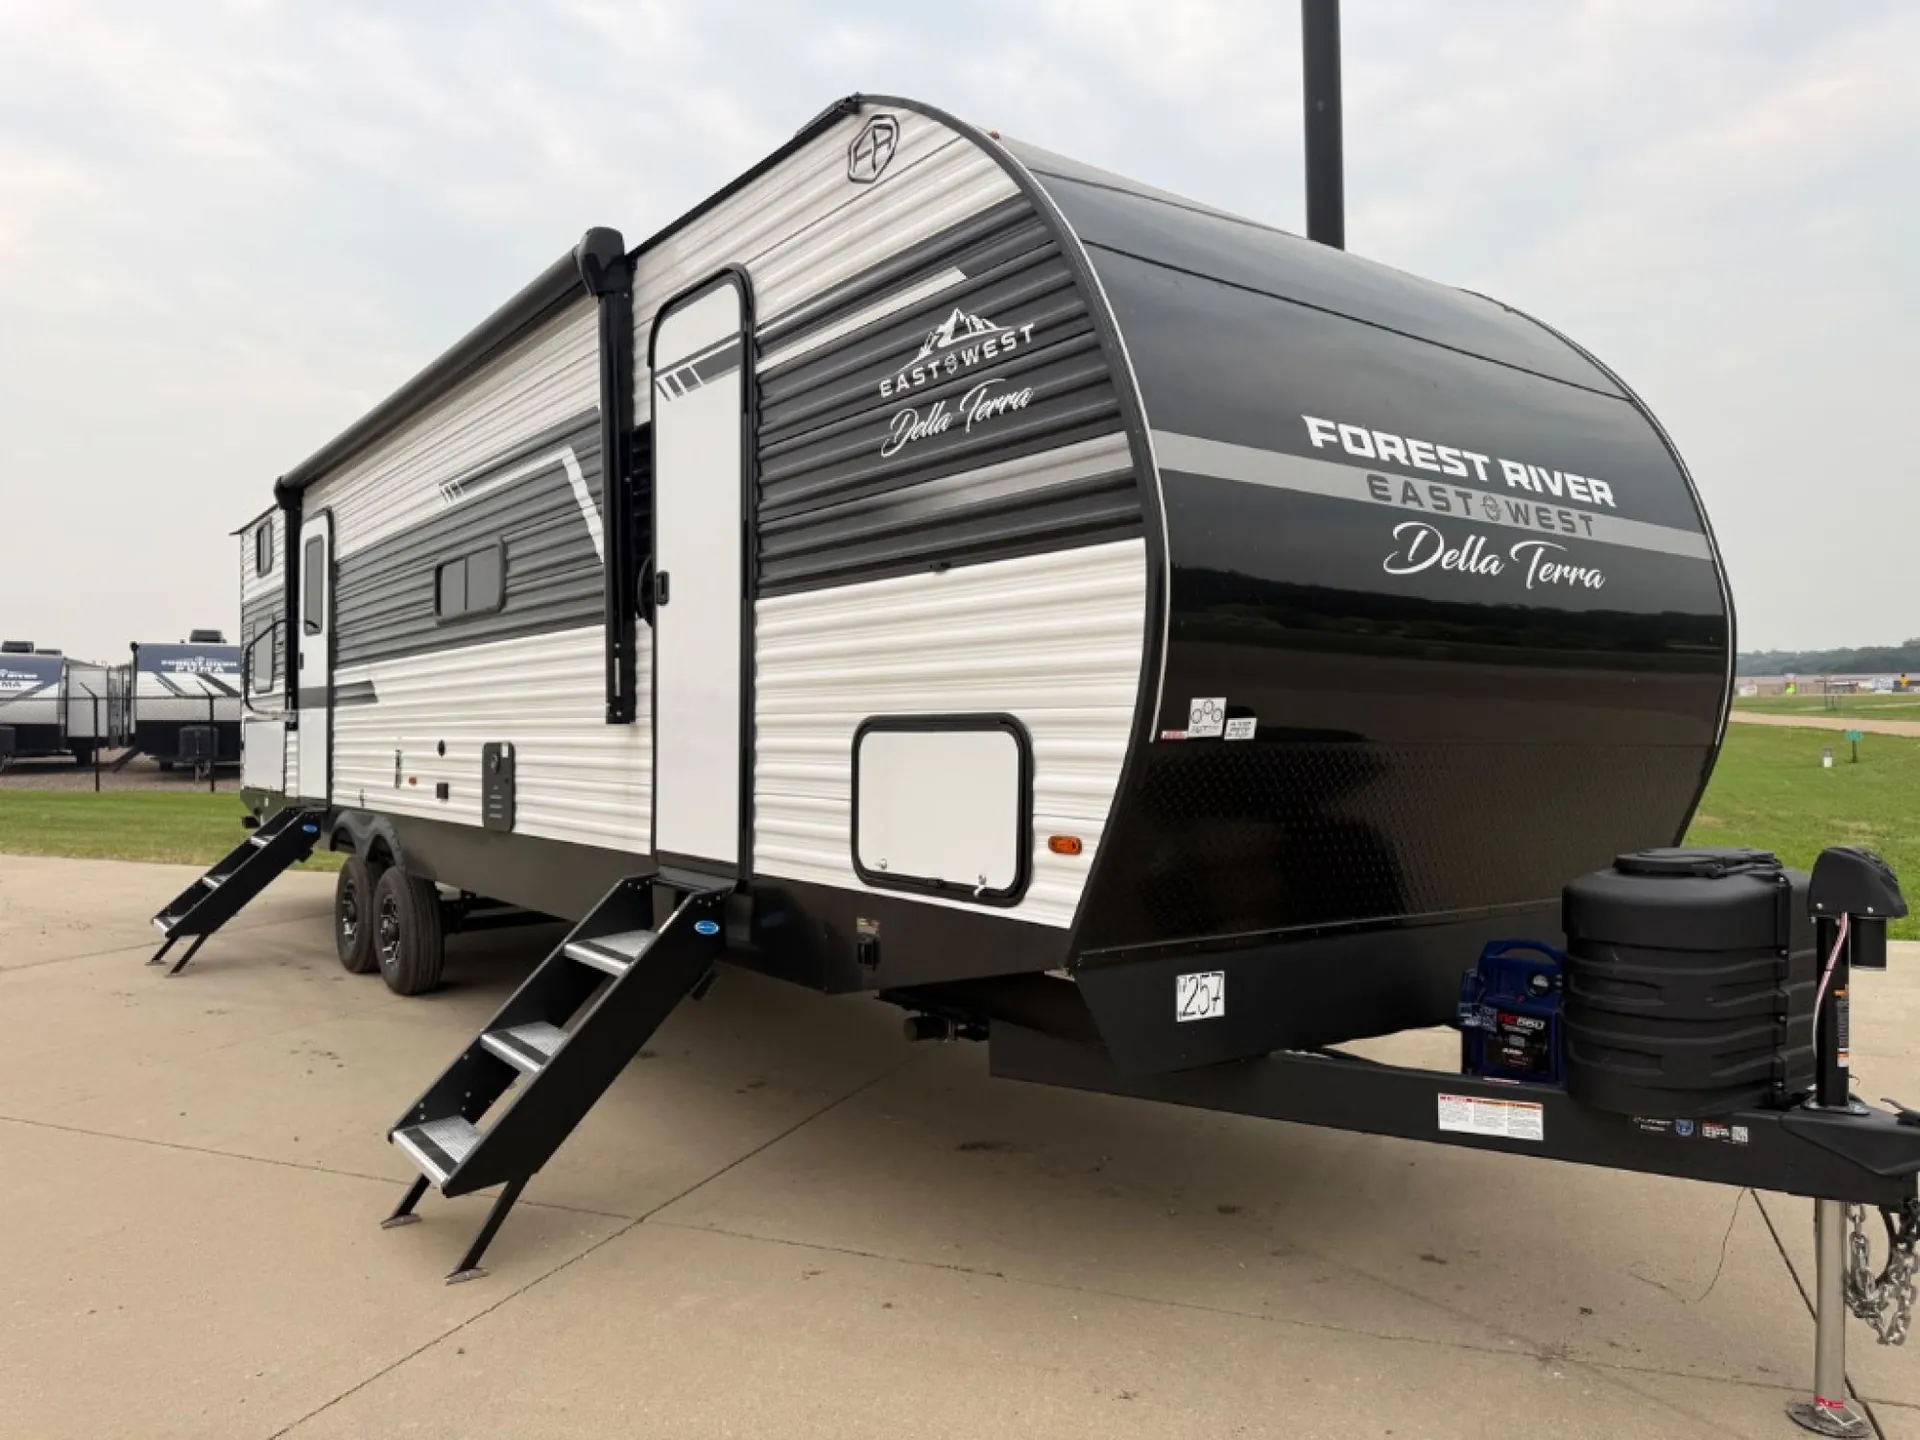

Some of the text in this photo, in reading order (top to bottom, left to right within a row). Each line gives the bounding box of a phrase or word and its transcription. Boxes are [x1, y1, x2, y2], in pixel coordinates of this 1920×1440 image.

[878, 323, 1035, 398] EAST WEST
[880, 378, 1034, 458] Della Terra
[1301, 415, 1617, 508] FOREST RIVER
[1366, 473, 1594, 537] EAST WEST
[1383, 520, 1606, 590] Della Terra
